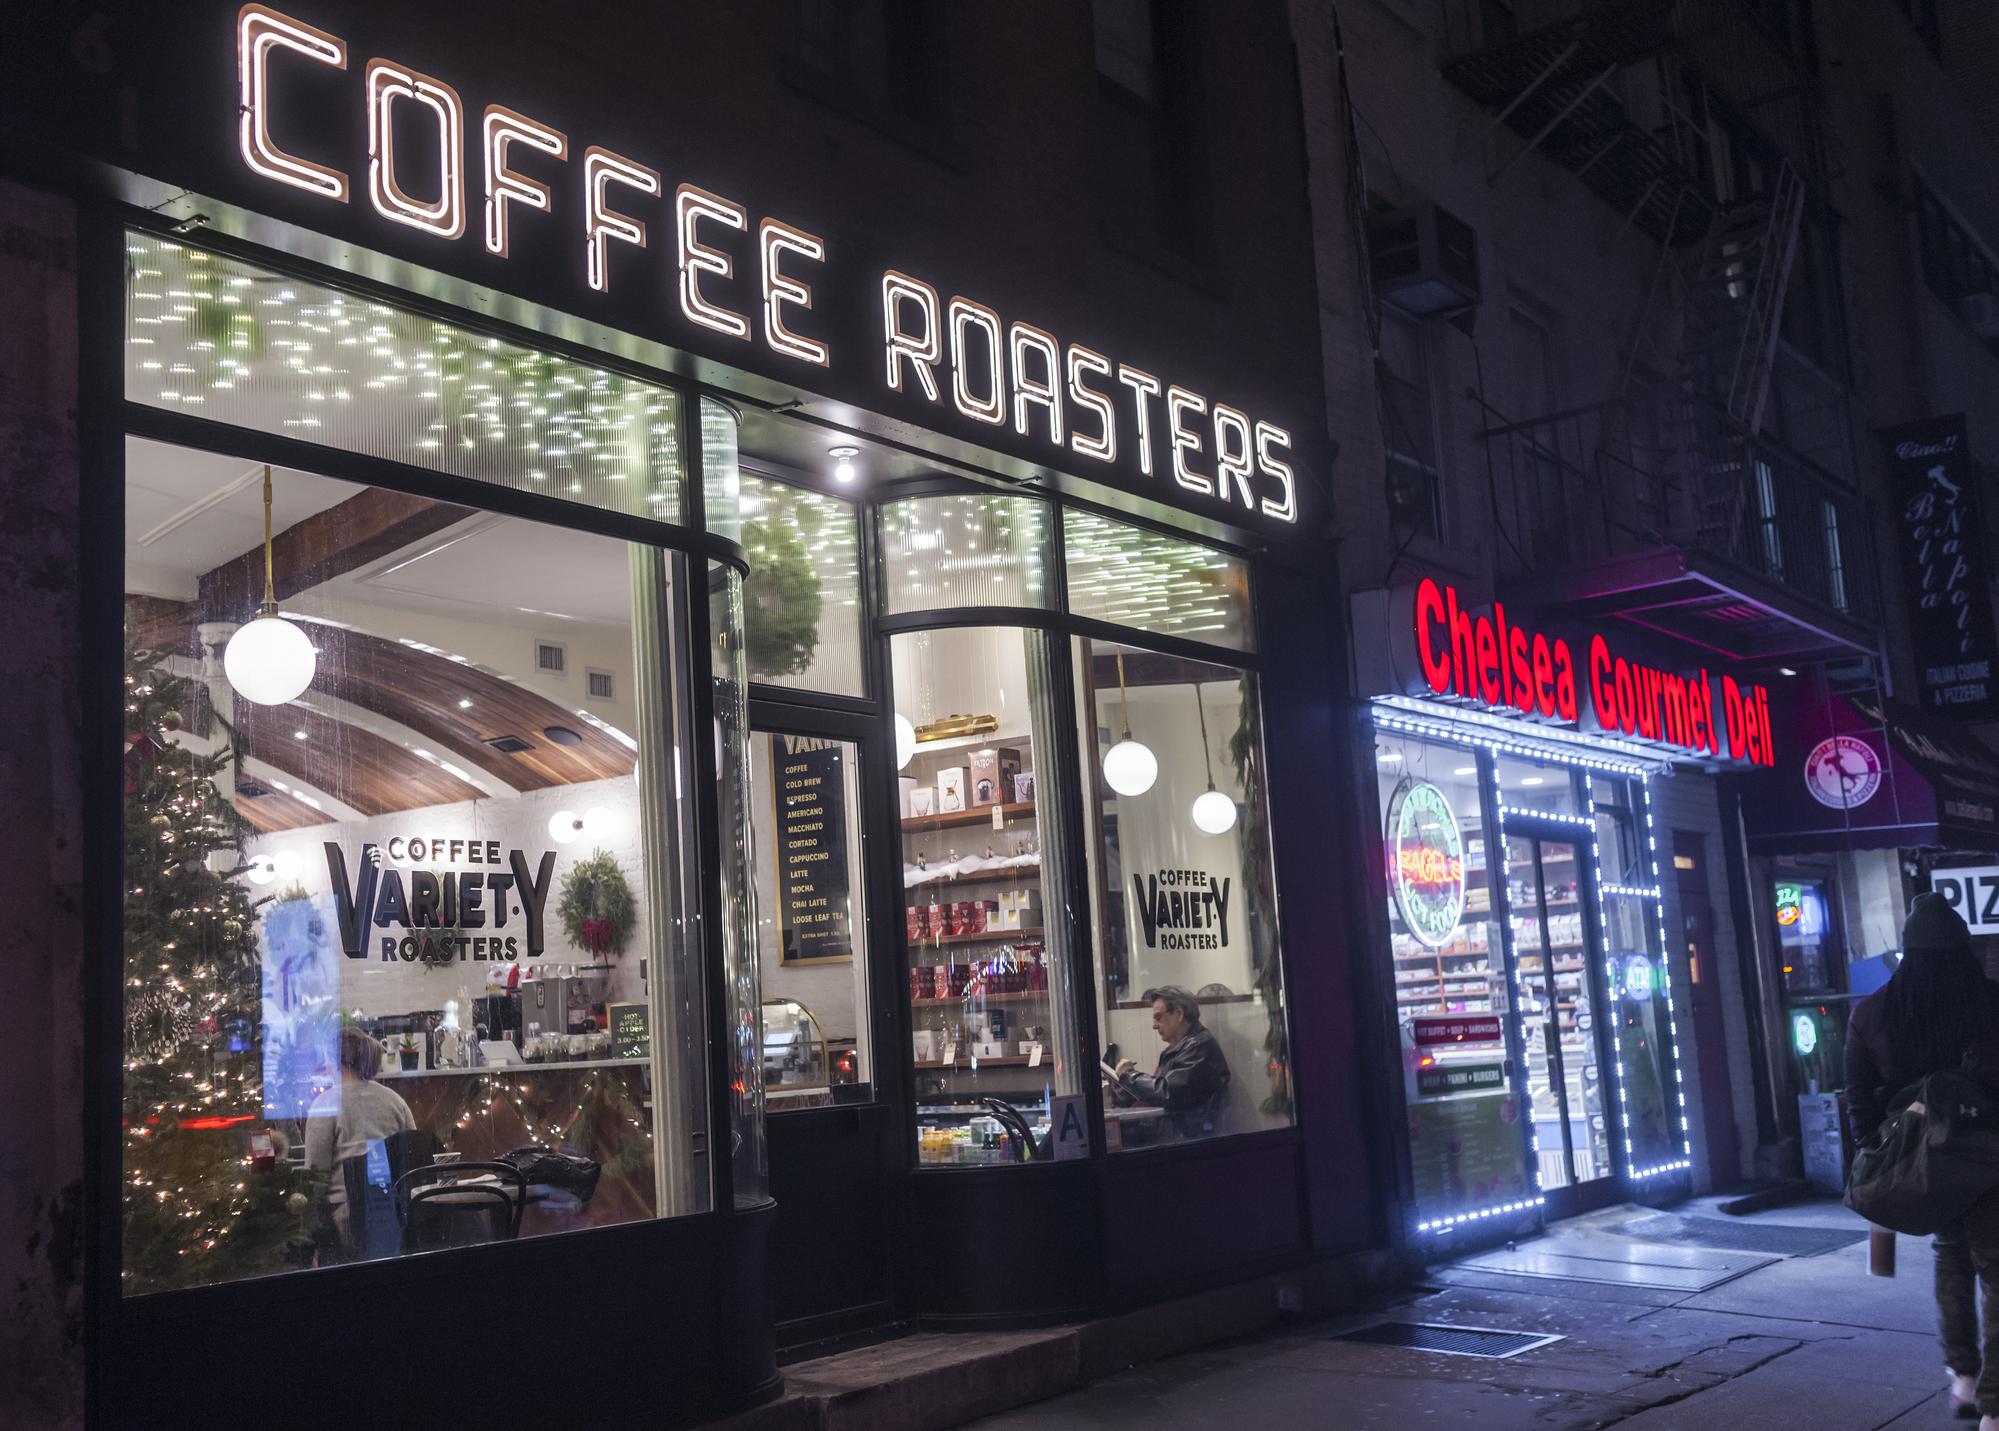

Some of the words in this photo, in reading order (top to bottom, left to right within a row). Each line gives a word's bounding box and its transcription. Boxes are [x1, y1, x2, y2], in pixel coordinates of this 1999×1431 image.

[238, 3, 829, 367] COFFEE
[882, 269, 1298, 524] ROASTERS
[1416, 577, 1578, 723] Chelsea
[1590, 633, 1719, 755] Gourmet
[1722, 674, 1774, 767] Deli
[785, 764, 808, 774] COFFEE
[786, 780, 802, 789] COLD
[804, 778, 821, 787] BREW
[787, 793, 817, 803] ESPRESSO
[787, 807, 823, 819] AMERICANO
[788, 822, 823, 833] MACCHIATO
[789, 839, 817, 848] CORTADO
[388, 836, 501, 865] COFFEE
[789, 852, 829, 863] CAPPUCCINO
[790, 869, 808, 879] LATTE
[1160, 869, 1207, 887] COFFEE
[791, 884, 814, 894] MOCHA
[323, 841, 558, 959] VARIETY
[792, 901, 807, 909] CHAI
[809, 898, 827, 907] LATTE
[1934, 875, 1999, 925] PIZ
[1133, 873, 1230, 948] VARIETY
[792, 915, 813, 924] LOOSE
[815, 913, 830, 922] LEAF
[832, 911, 844, 920] TEA
[1161, 933, 1218, 950] ROASTERS
[381, 936, 518, 962] ROASTERS
[1060, 1102, 1084, 1142] A
